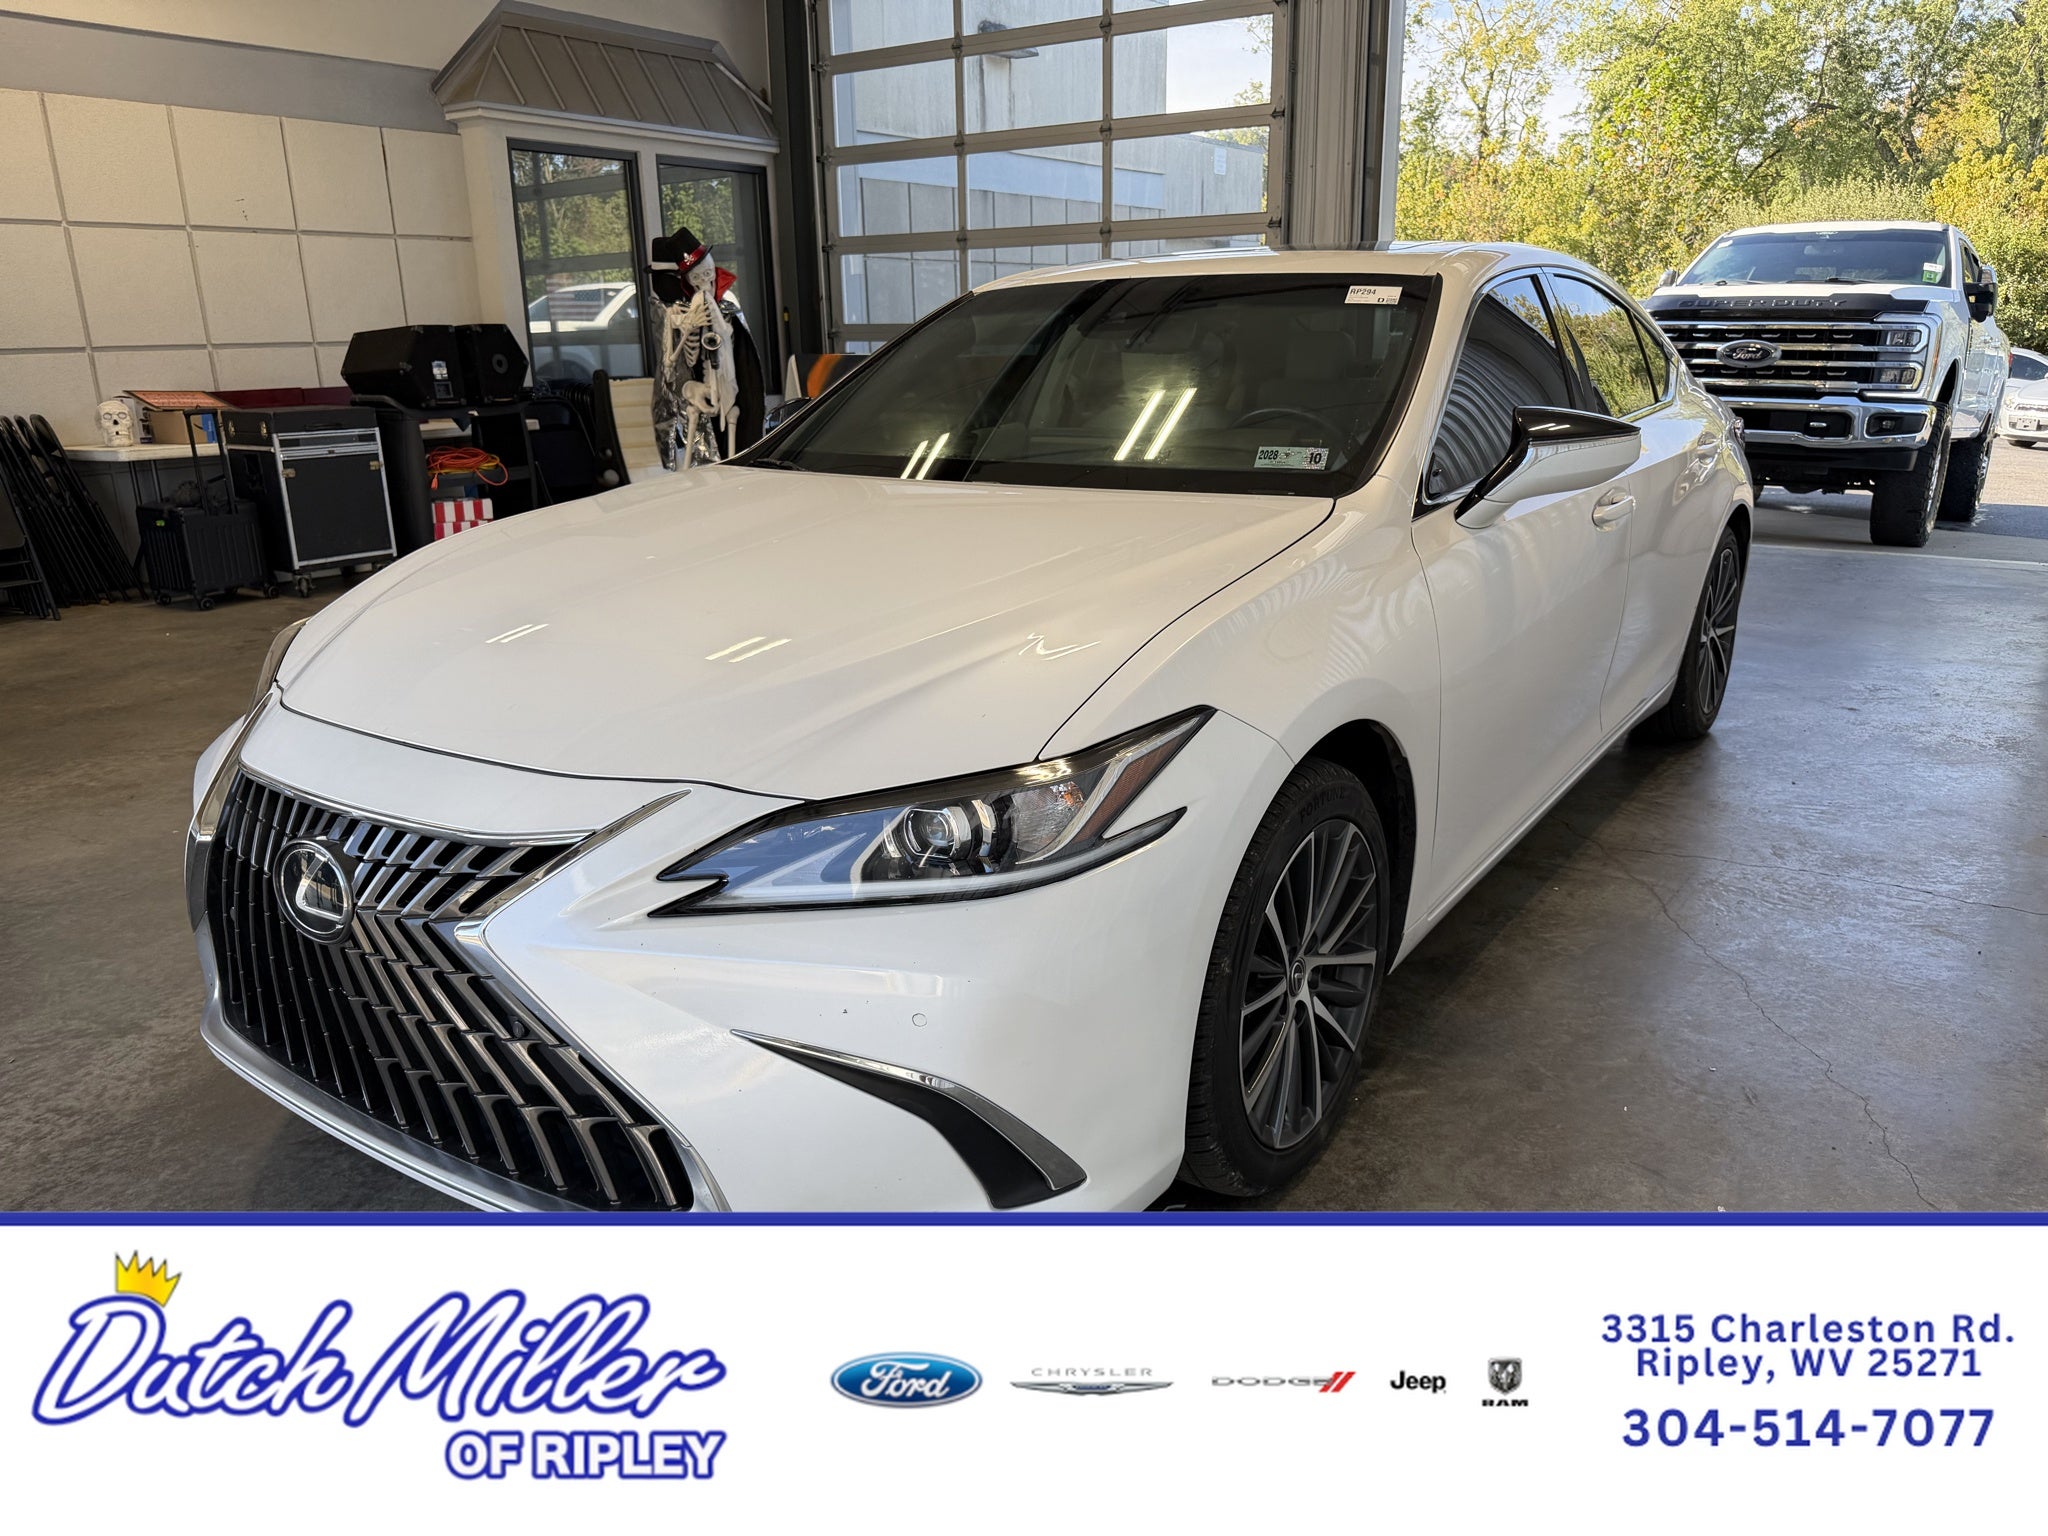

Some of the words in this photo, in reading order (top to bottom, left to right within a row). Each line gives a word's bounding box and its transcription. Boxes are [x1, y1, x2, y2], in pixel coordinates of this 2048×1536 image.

[1350, 288, 1377, 296] RP294
[1678, 299, 1767, 308] SUPER
[1771, 299, 1848, 308] DUTY
[1732, 347, 1763, 360] Ford
[1258, 450, 1279, 460] 2028
[1309, 452, 1322, 465] 10
